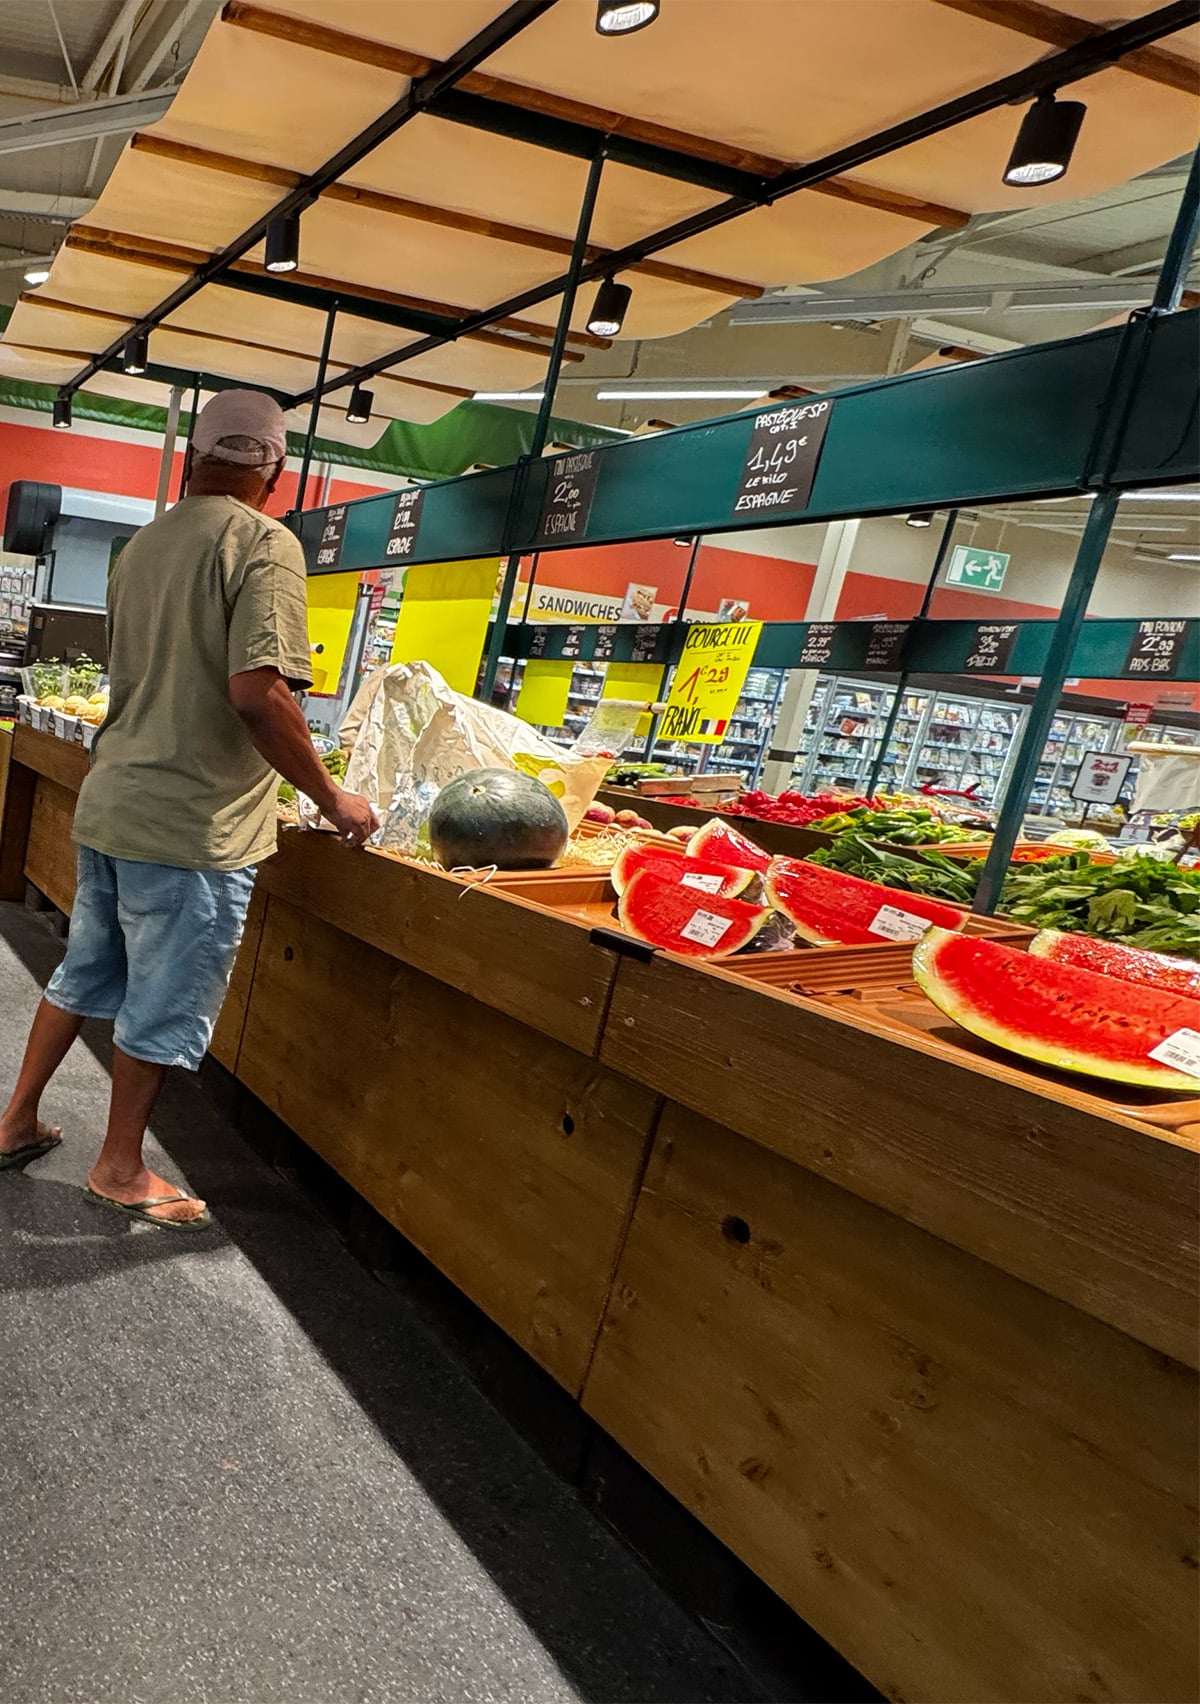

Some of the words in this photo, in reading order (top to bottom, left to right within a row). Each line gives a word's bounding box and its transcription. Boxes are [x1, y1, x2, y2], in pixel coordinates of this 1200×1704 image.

[745, 477, 761, 488] LE
[735, 488, 798, 511] ESPAGNE
[544, 511, 578, 535] ESPAGNE
[538, 595, 623, 622] SANDWICHES
